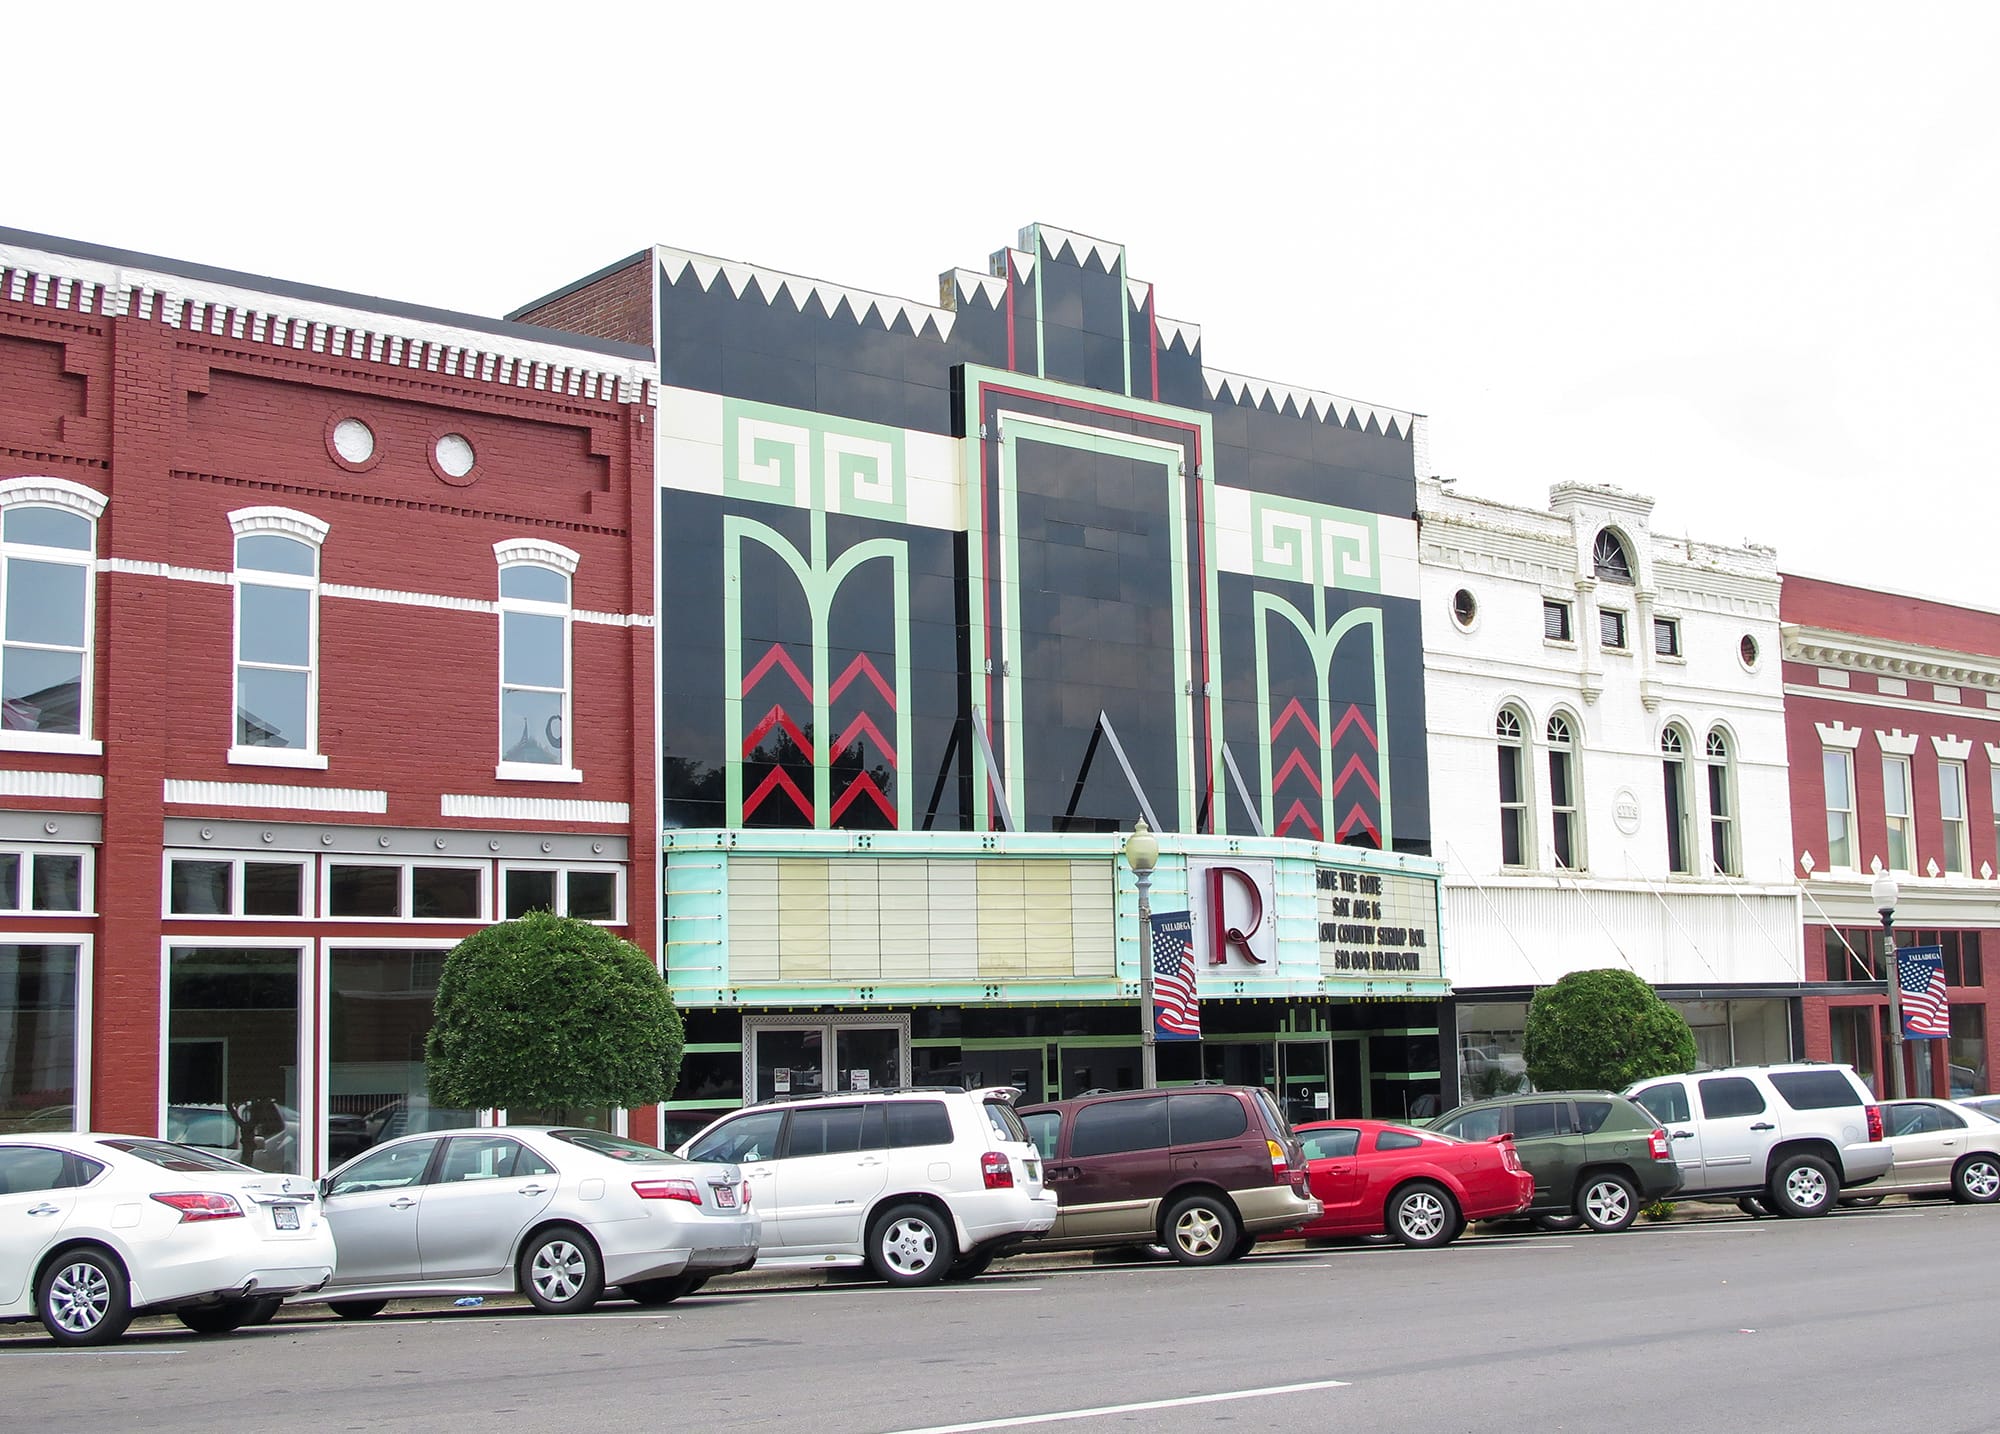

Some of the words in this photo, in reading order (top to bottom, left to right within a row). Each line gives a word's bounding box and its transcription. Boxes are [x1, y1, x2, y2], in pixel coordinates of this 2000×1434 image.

[1316, 869, 1338, 891] SAVE
[1339, 872, 1357, 893] THE
[1205, 867, 1266, 965] R
[1332, 897, 1350, 917] SAT
[1353, 899, 1371, 920] AUG
[1371, 901, 1381, 920] 16
[1161, 921, 1191, 932] TALLADEGA
[1318, 921, 1337, 942] LOW
[1338, 923, 1375, 944] COUNTRY
[1377, 926, 1407, 946] SHRIMP
[1408, 928, 1427, 947] BOIL
[1371, 951, 1420, 971] DRAWDOWN
[1909, 953, 1940, 961] TALLADEGA
